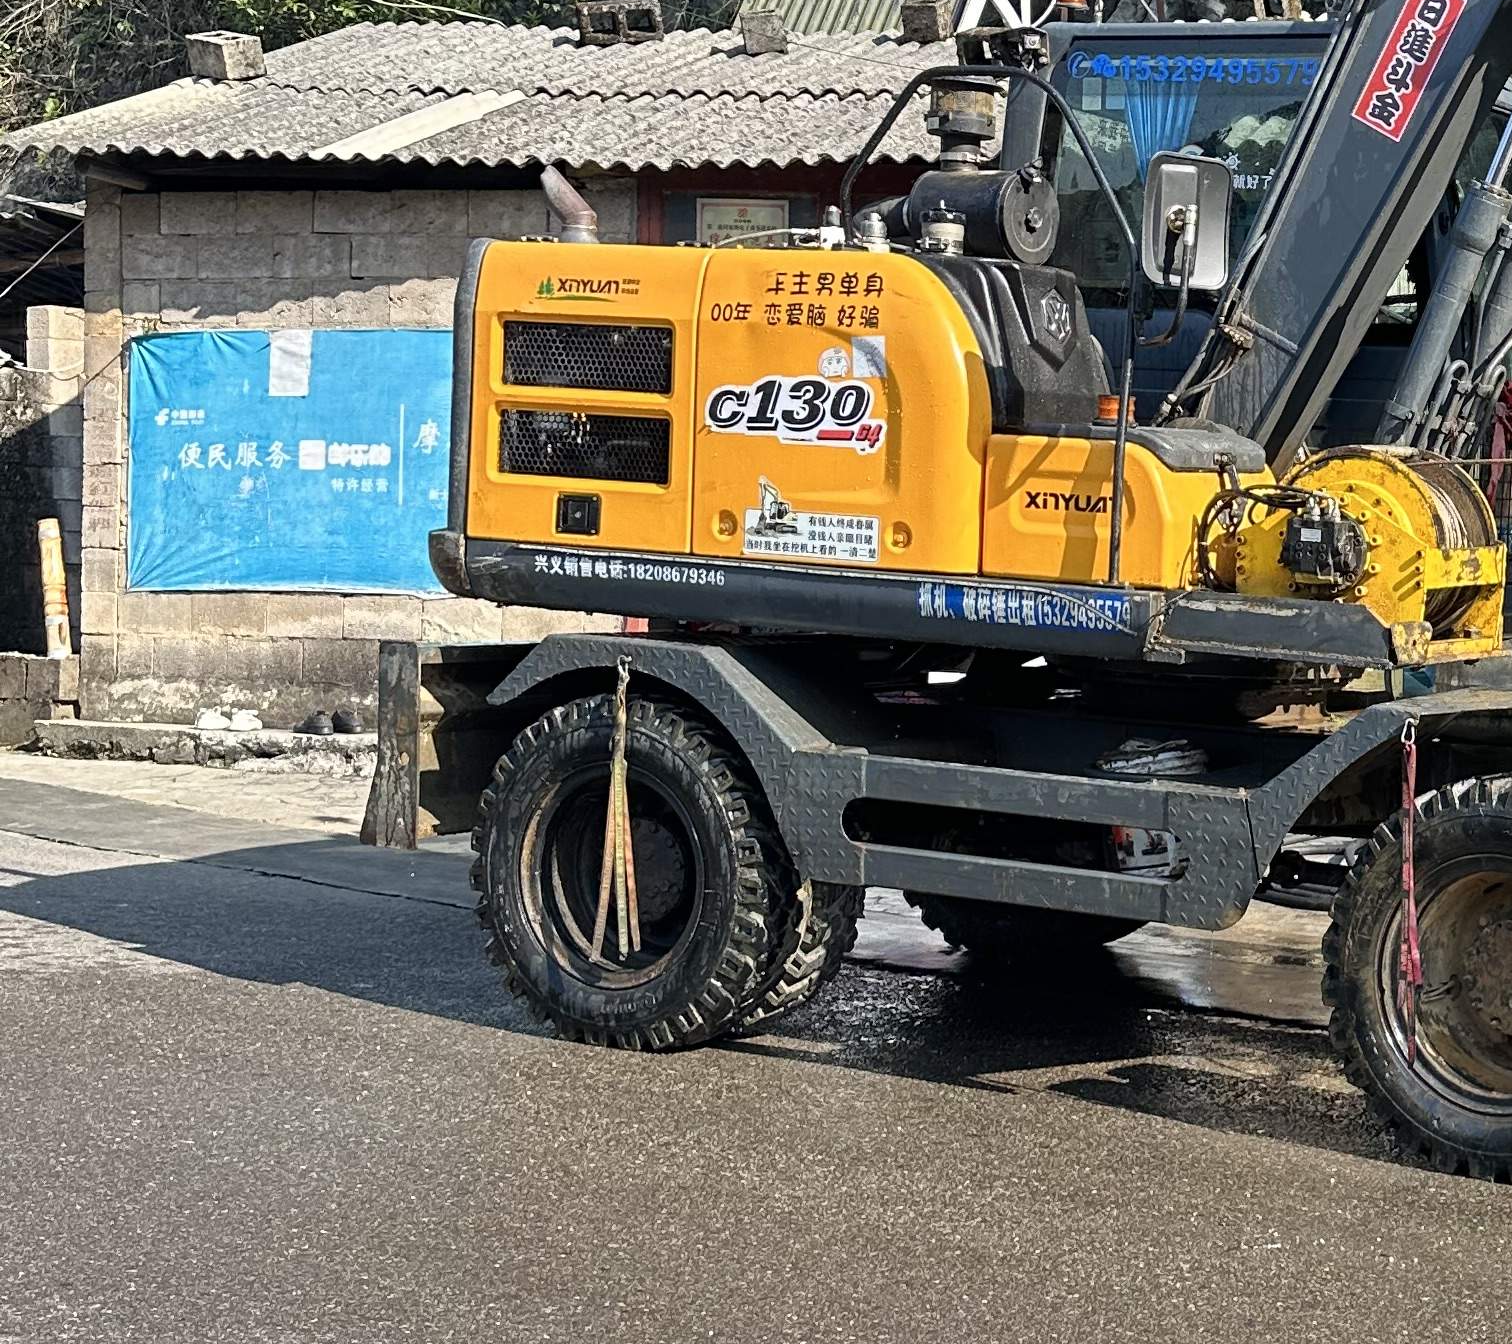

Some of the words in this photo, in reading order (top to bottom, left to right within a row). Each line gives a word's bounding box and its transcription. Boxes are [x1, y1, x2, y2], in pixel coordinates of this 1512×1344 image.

[1119, 54, 1319, 86] 15329495579
[711, 302, 752, 322] 00年
[764, 302, 827, 328] 恋爱脑
[837, 304, 880, 329] 好骗
[708, 379, 870, 432] C130
[855, 423, 883, 449] G4
[178, 441, 292, 470] 便民服务
[330, 477, 390, 493] 特许经营
[1024, 490, 1113, 514] XINYUA
[534, 554, 726, 587] 兴义销售电话:18208679346
